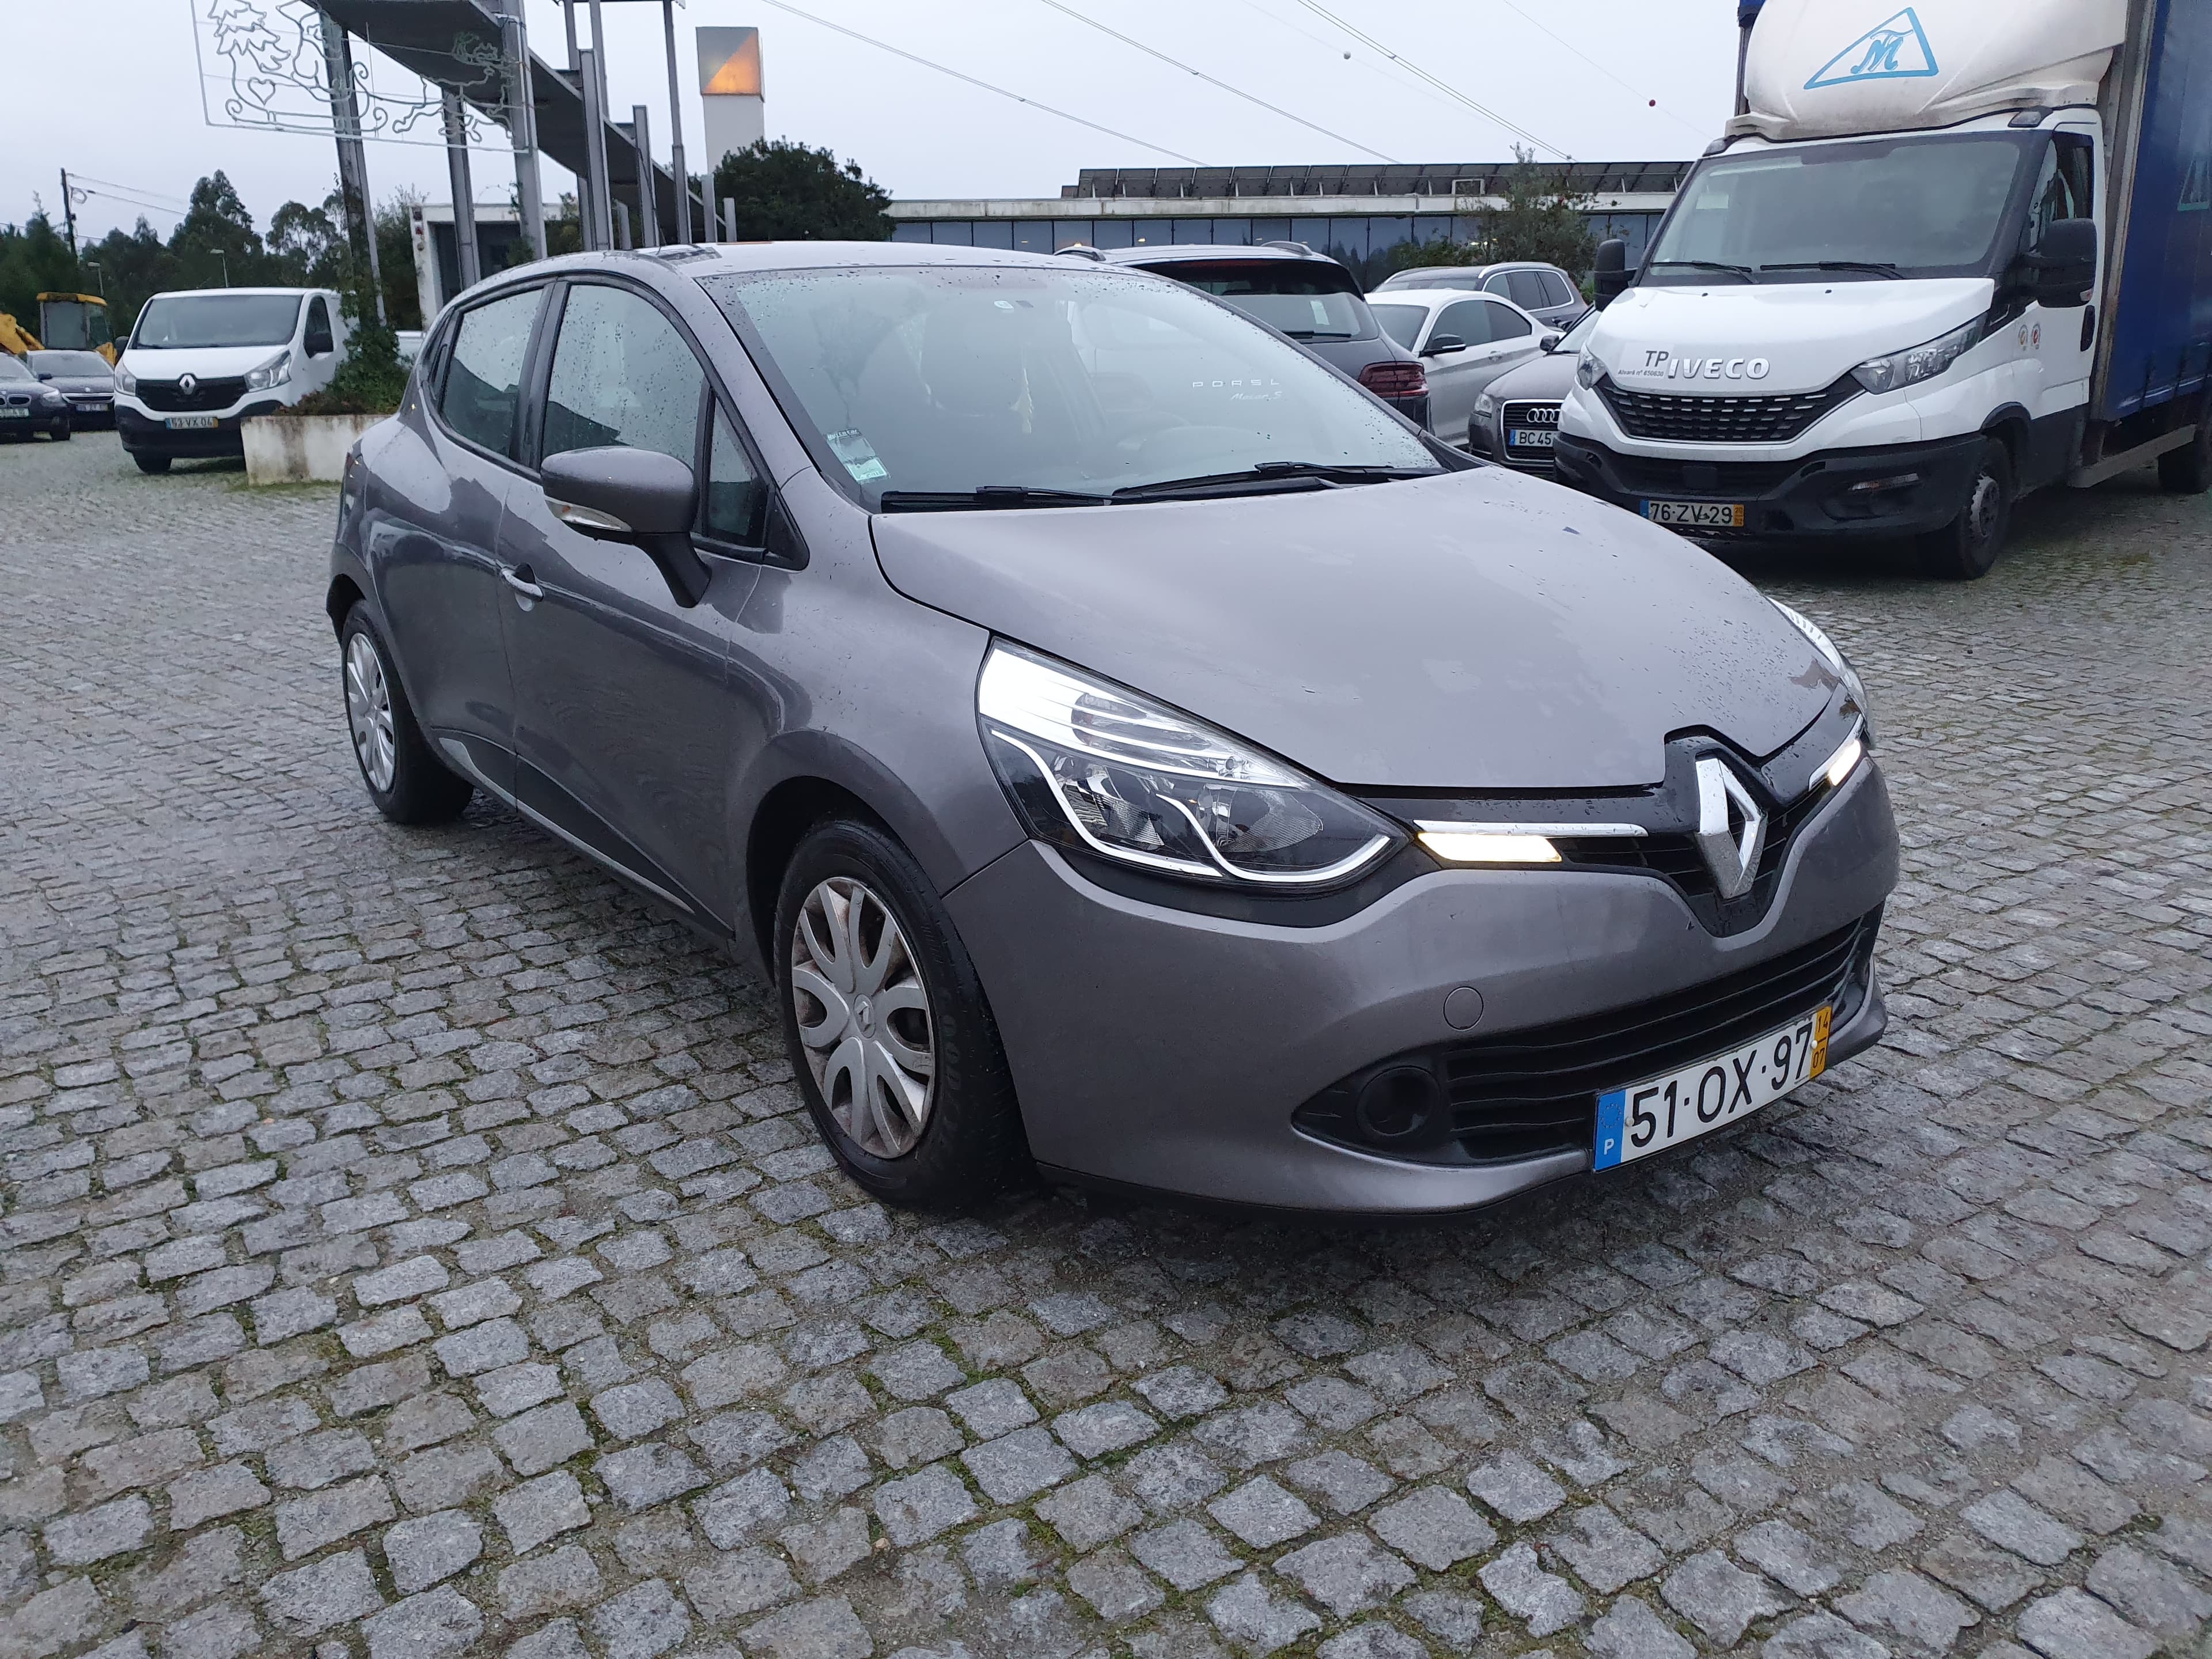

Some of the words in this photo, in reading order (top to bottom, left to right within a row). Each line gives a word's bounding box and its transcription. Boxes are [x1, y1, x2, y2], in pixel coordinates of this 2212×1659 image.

[1645, 350, 1669, 368] TP
[1668, 358, 1770, 380] IVECO
[1818, 1012, 1828, 1033] 14
[1813, 1047, 1825, 1069] 07
[1603, 1138, 1614, 1156] P
